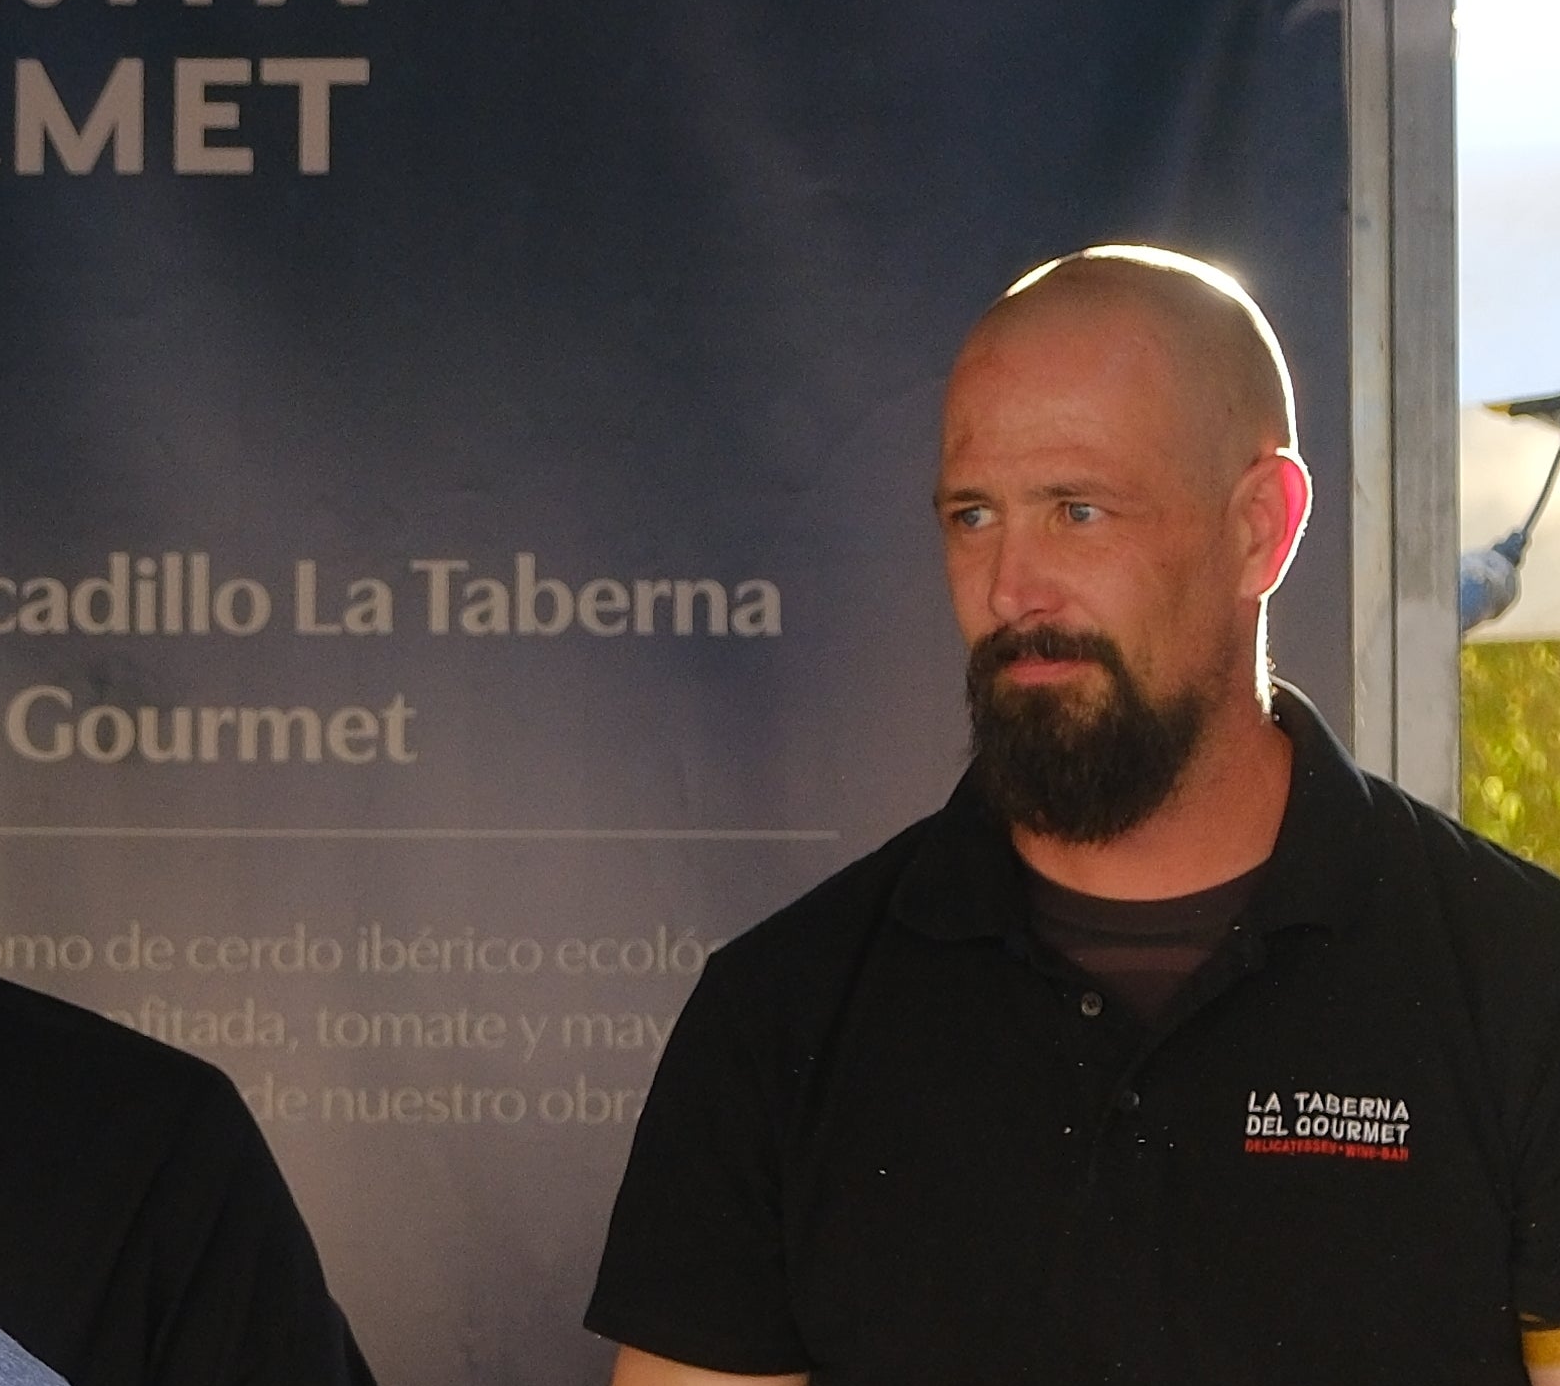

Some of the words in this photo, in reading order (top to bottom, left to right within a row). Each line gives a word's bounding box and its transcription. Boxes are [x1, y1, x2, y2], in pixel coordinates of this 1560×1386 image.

[293, 558, 395, 639] La
[409, 551, 784, 639] Taberna
[4, 682, 420, 766] Gourmet
[104, 922, 174, 975] de
[186, 923, 343, 976] cerdo
[357, 924, 543, 977] ibérico
[554, 925, 731, 979] ecoló
[316, 1007, 508, 1054] tomate
[515, 1015, 548, 1061] y
[561, 1013, 676, 1061] may
[321, 1081, 528, 1127] nuestro
[1245, 1115, 1289, 1136] DEL
[1295, 1116, 1410, 1144] GOURMET
[1247, 1091, 1281, 1113] LA
[1294, 1091, 1409, 1121] TABERNA
